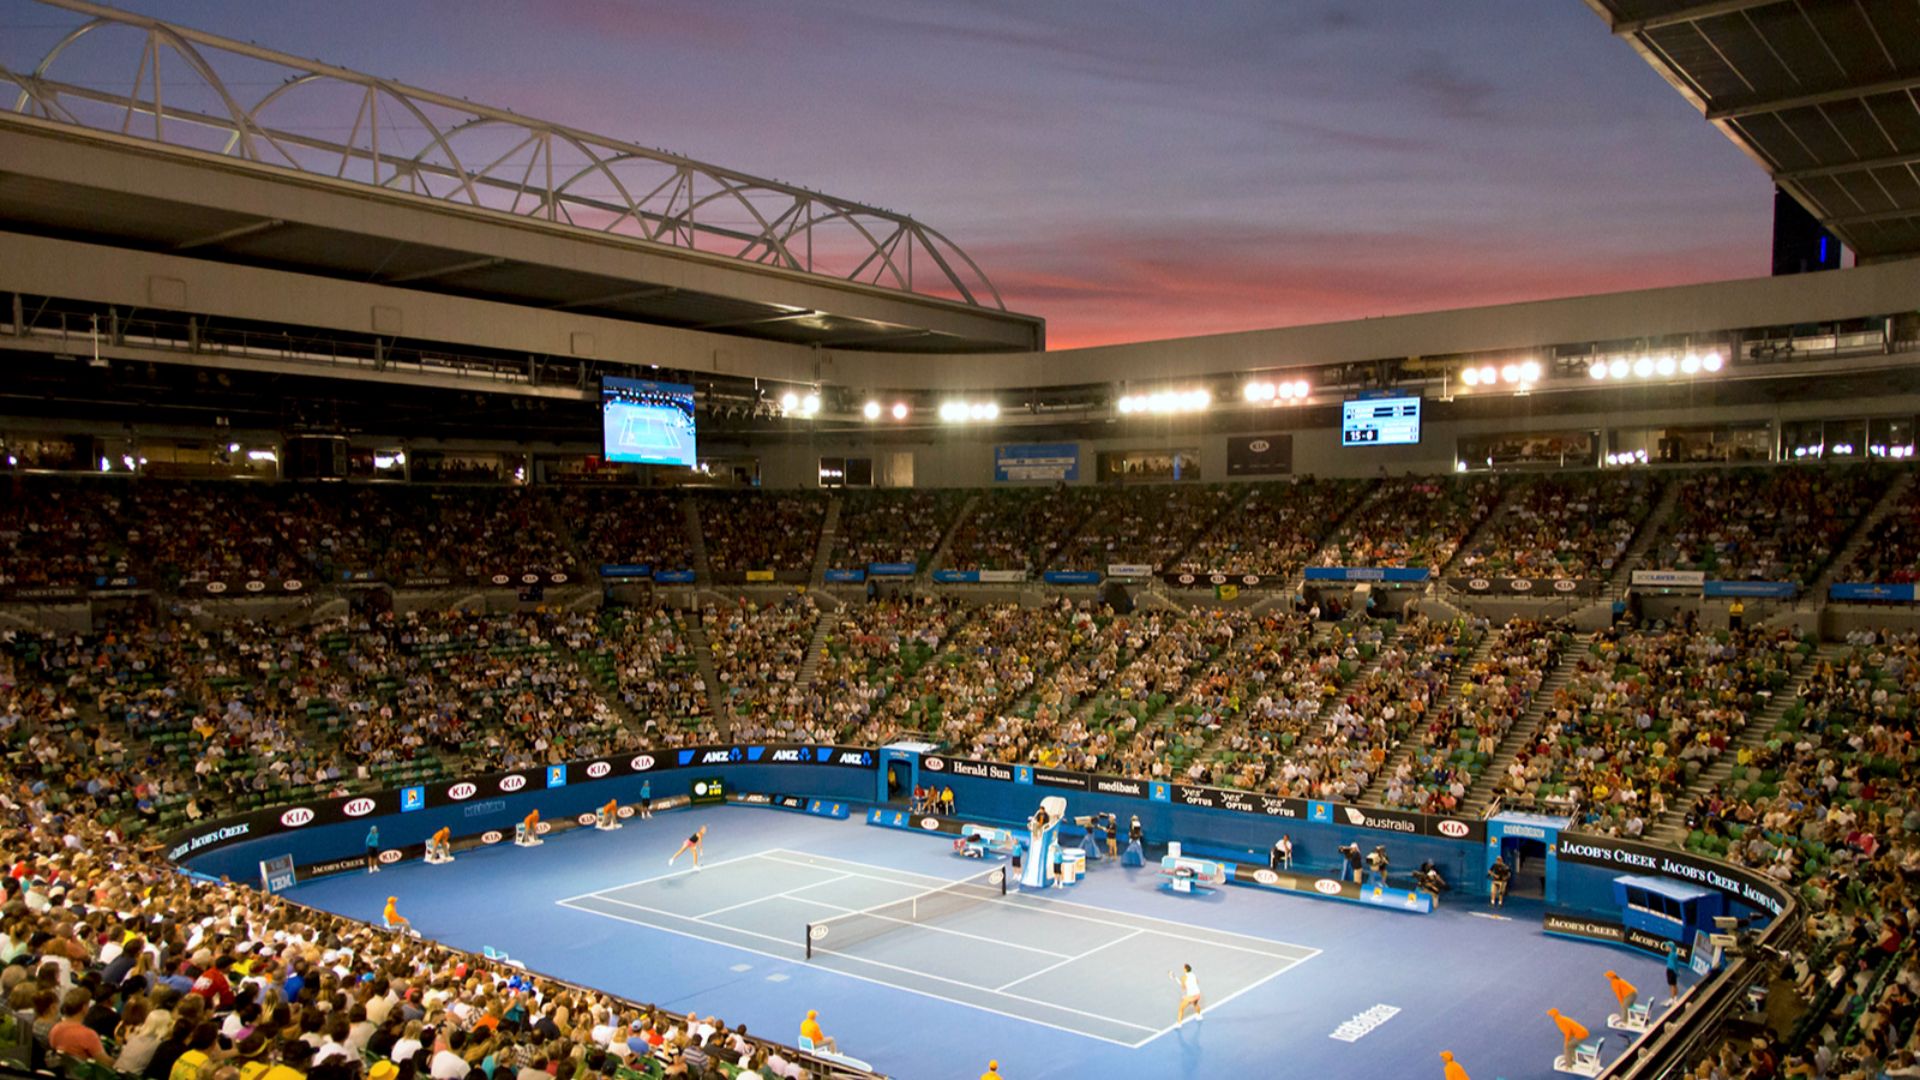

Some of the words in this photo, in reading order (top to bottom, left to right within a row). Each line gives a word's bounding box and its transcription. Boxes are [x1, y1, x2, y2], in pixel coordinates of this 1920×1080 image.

[702, 751, 729, 763] ANZ
[772, 749, 799, 761] ANZ
[839, 752, 862, 765] ANZ
[953, 761, 988, 776] Herald
[989, 766, 1011, 780] Sun
[1098, 781, 1140, 795] medibank
[1186, 796, 1213, 807] OPTUS
[1225, 802, 1253, 812] OPTUS
[1266, 807, 1295, 817] OPTUS
[219, 823, 249, 840] CREEK
[1365, 816, 1415, 832] australia
[1560, 840, 1612, 861] JACOB'S
[1613, 849, 1657, 869] CREEK
[1661, 858, 1706, 883] JACOB'S
[1707, 870, 1740, 894] CREEK
[270, 874, 293, 892] IBM
[1548, 918, 1585, 932] JACOB'S
[1586, 923, 1620, 937] CREEK
[1629, 932, 1660, 948] JACOB'S
